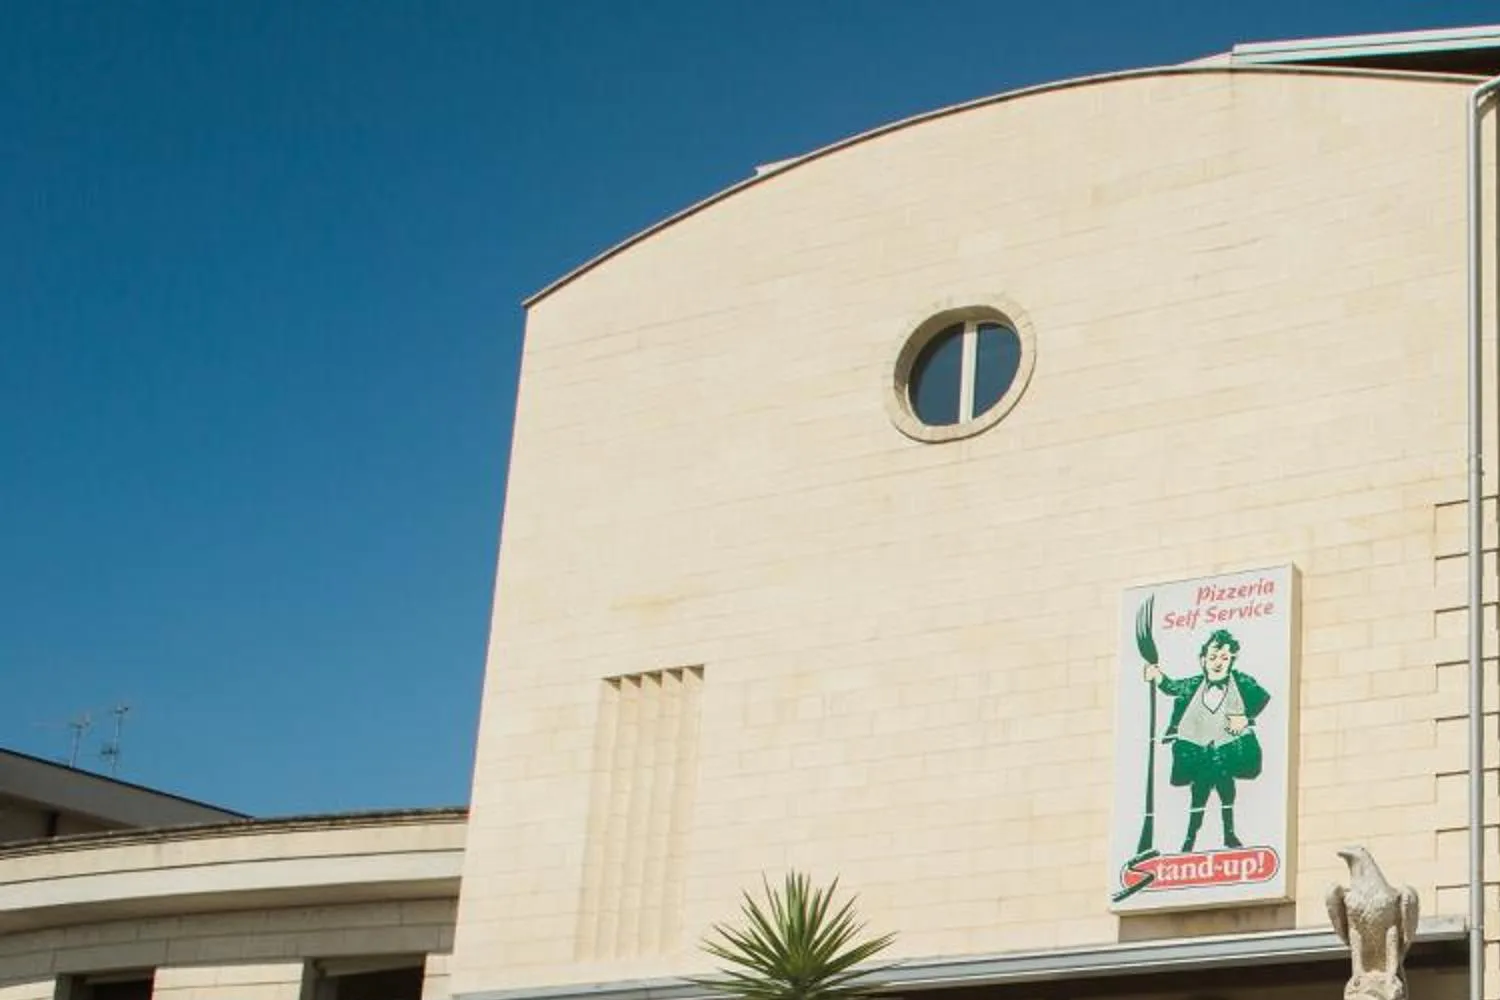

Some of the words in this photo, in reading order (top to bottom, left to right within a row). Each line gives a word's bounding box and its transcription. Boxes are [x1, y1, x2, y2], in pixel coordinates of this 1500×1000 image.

[1162, 608, 1201, 629] Self
[1206, 600, 1275, 623] Service
[1112, 850, 1265, 902] Stand-up!
